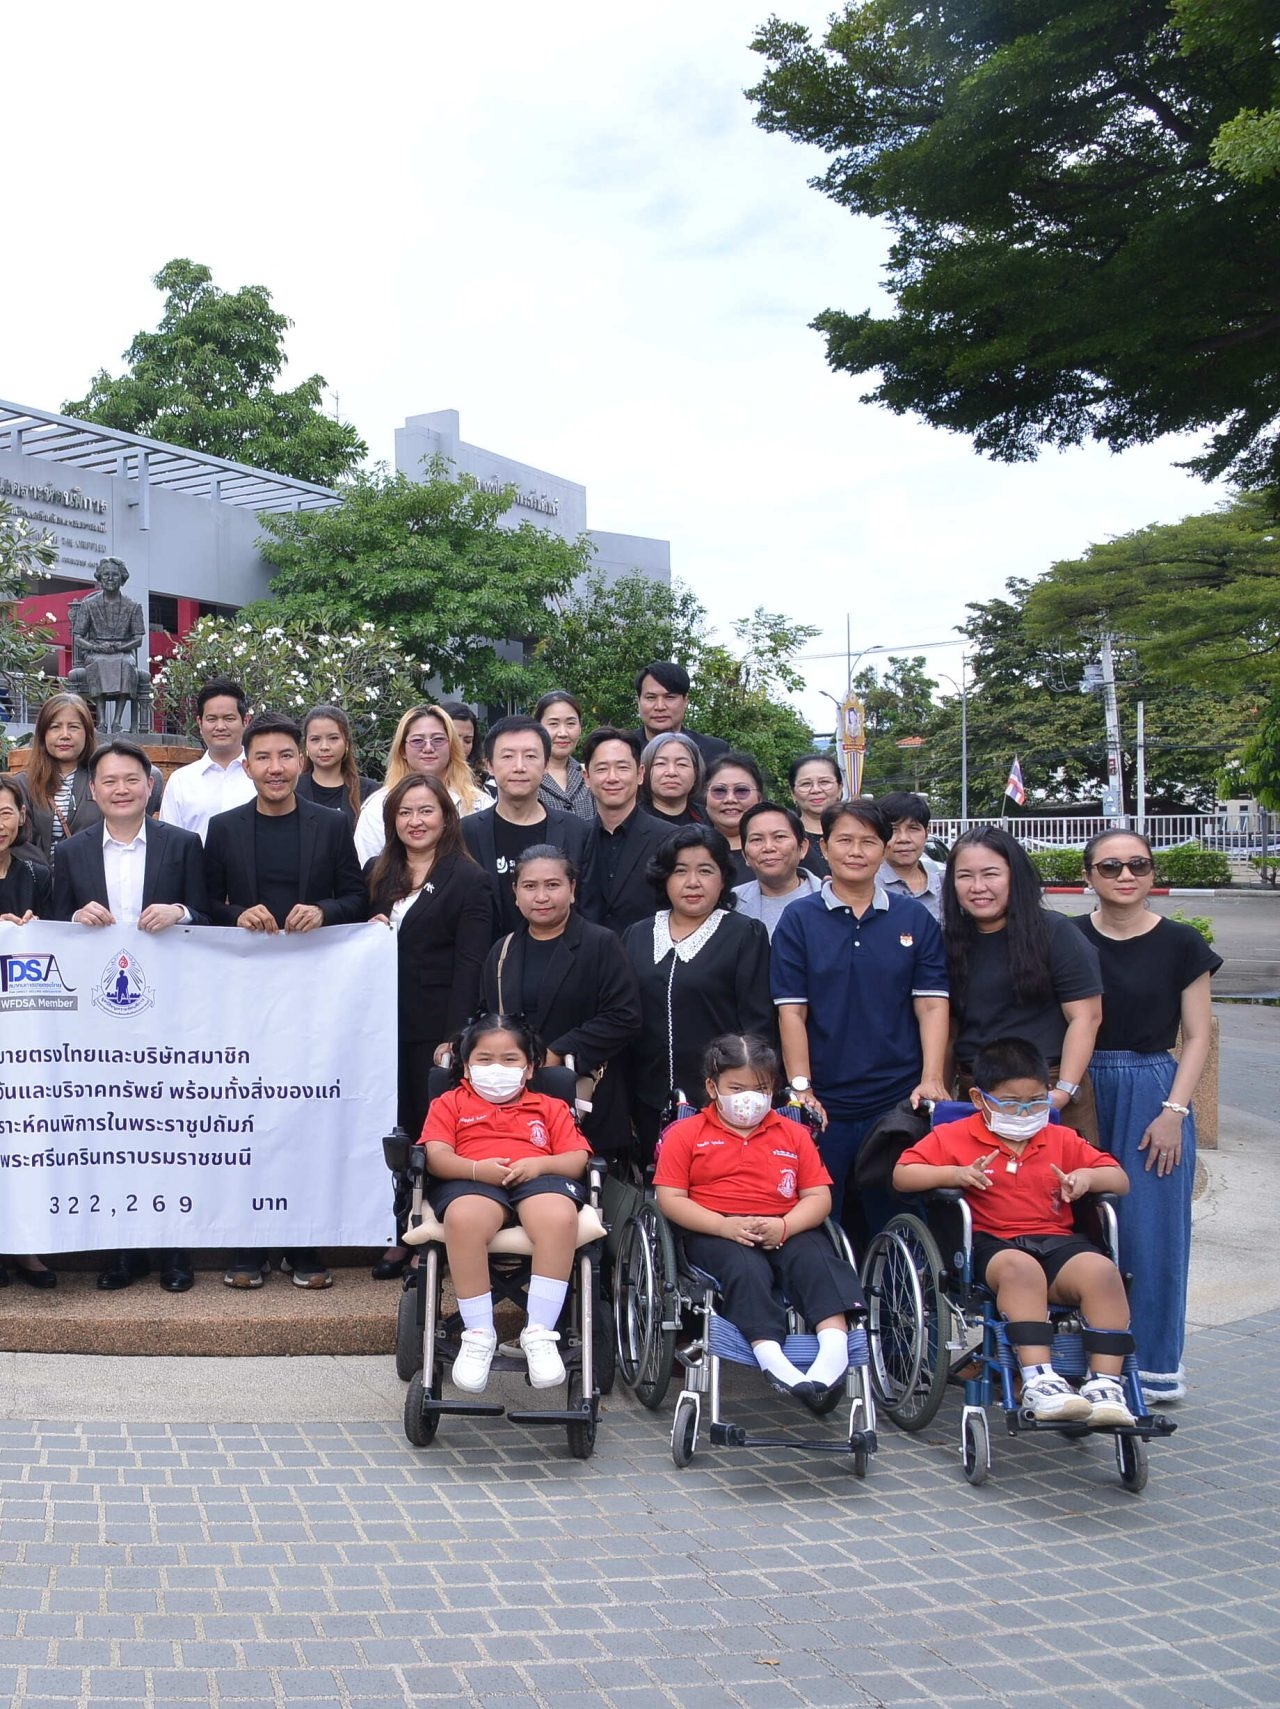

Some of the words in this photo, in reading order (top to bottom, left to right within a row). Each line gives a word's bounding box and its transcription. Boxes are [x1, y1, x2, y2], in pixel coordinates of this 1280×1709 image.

[1, 998, 37, 1009] WFDSA
[38, 998, 74, 1008] Member
[169, 1076, 341, 1100] พร้อมทั้งสิ่งของแก่
[252, 1197, 288, 1211] บาท
